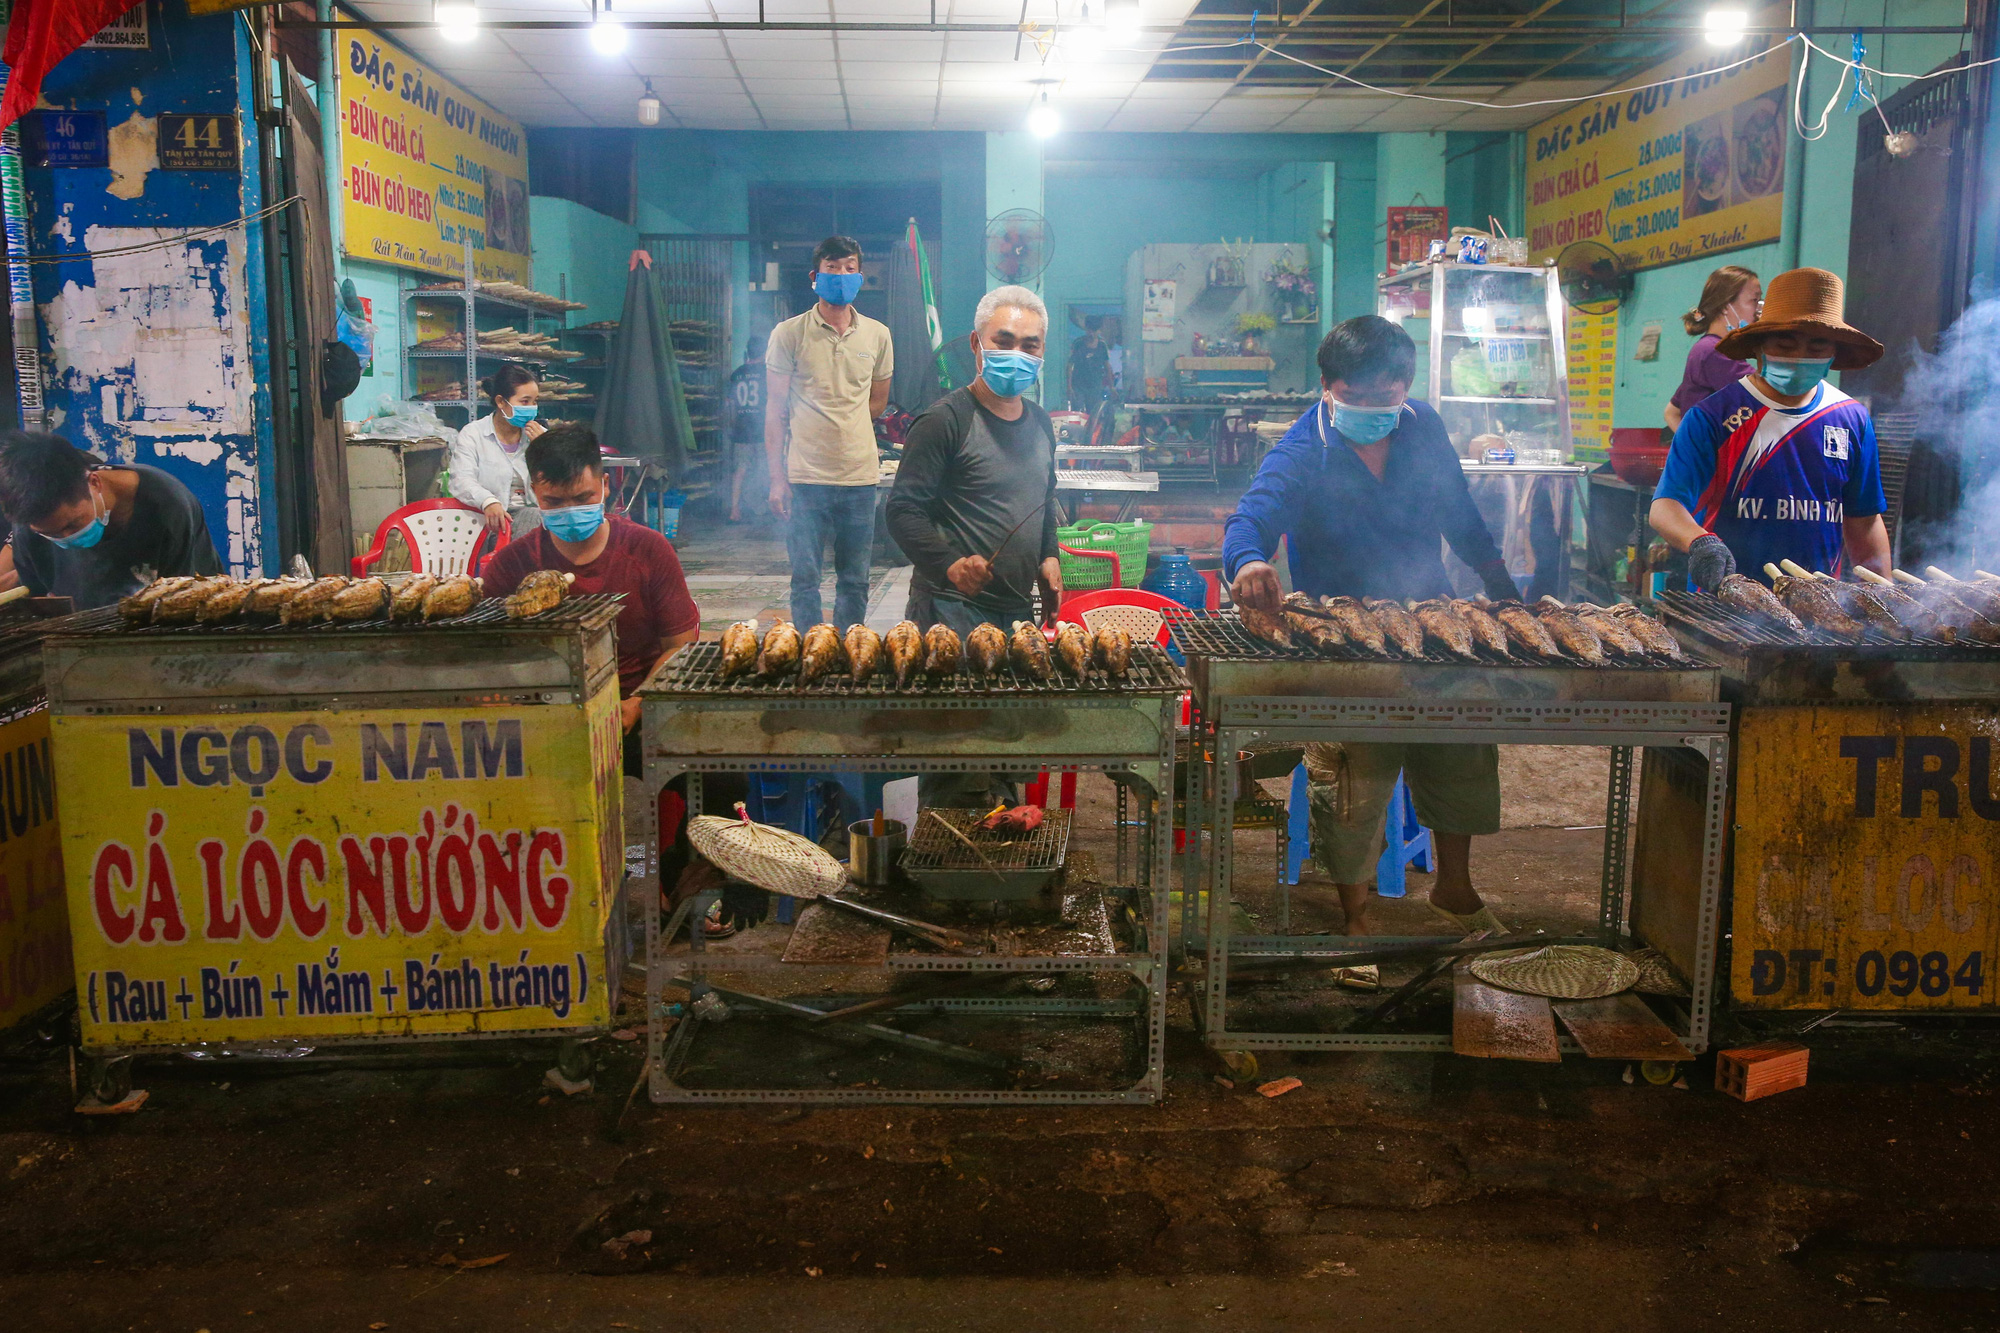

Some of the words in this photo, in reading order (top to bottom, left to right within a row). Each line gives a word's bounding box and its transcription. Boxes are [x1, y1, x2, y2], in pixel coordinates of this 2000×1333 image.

[56, 115, 75, 138] 46
[349, 95, 379, 146] BÚN
[382, 112, 408, 158] CHẢ
[409, 123, 426, 165] CÁ
[350, 40, 396, 92] ĐẶC
[400, 68, 439, 116] SẢN
[443, 96, 476, 135] QUY
[479, 116, 518, 158] NHƠN
[1536, 124, 1573, 161] ĐẶC
[1576, 101, 1621, 145] SẢN
[1626, 75, 1676, 122] QUY
[174, 117, 223, 149] 44
[351, 160, 381, 208] BÚN
[384, 172, 406, 216] GIÒ
[407, 185, 432, 224] HEO
[1557, 158, 1580, 198] CHẢ
[1582, 151, 1599, 189] CÁ
[1556, 210, 1575, 246] GIÒ
[1577, 208, 1603, 241] HEO
[1737, 497, 1767, 519] KV.
[1777, 494, 1820, 521] BÌNH
[129, 724, 333, 797] NGỌC
[361, 719, 523, 782] NAM
[94, 812, 186, 944] CÁ
[200, 809, 329, 939] LÓC
[341, 804, 568, 935] NƯỚNG
[105, 971, 167, 1023] Rau
[201, 961, 263, 1019] Bún
[298, 947, 373, 1015] Mắm
[405, 953, 483, 1011] Bánh
[489, 950, 569, 1018] tráng
[1750, 949, 1836, 996] ĐT:
[1855, 950, 1984, 997] 0984
